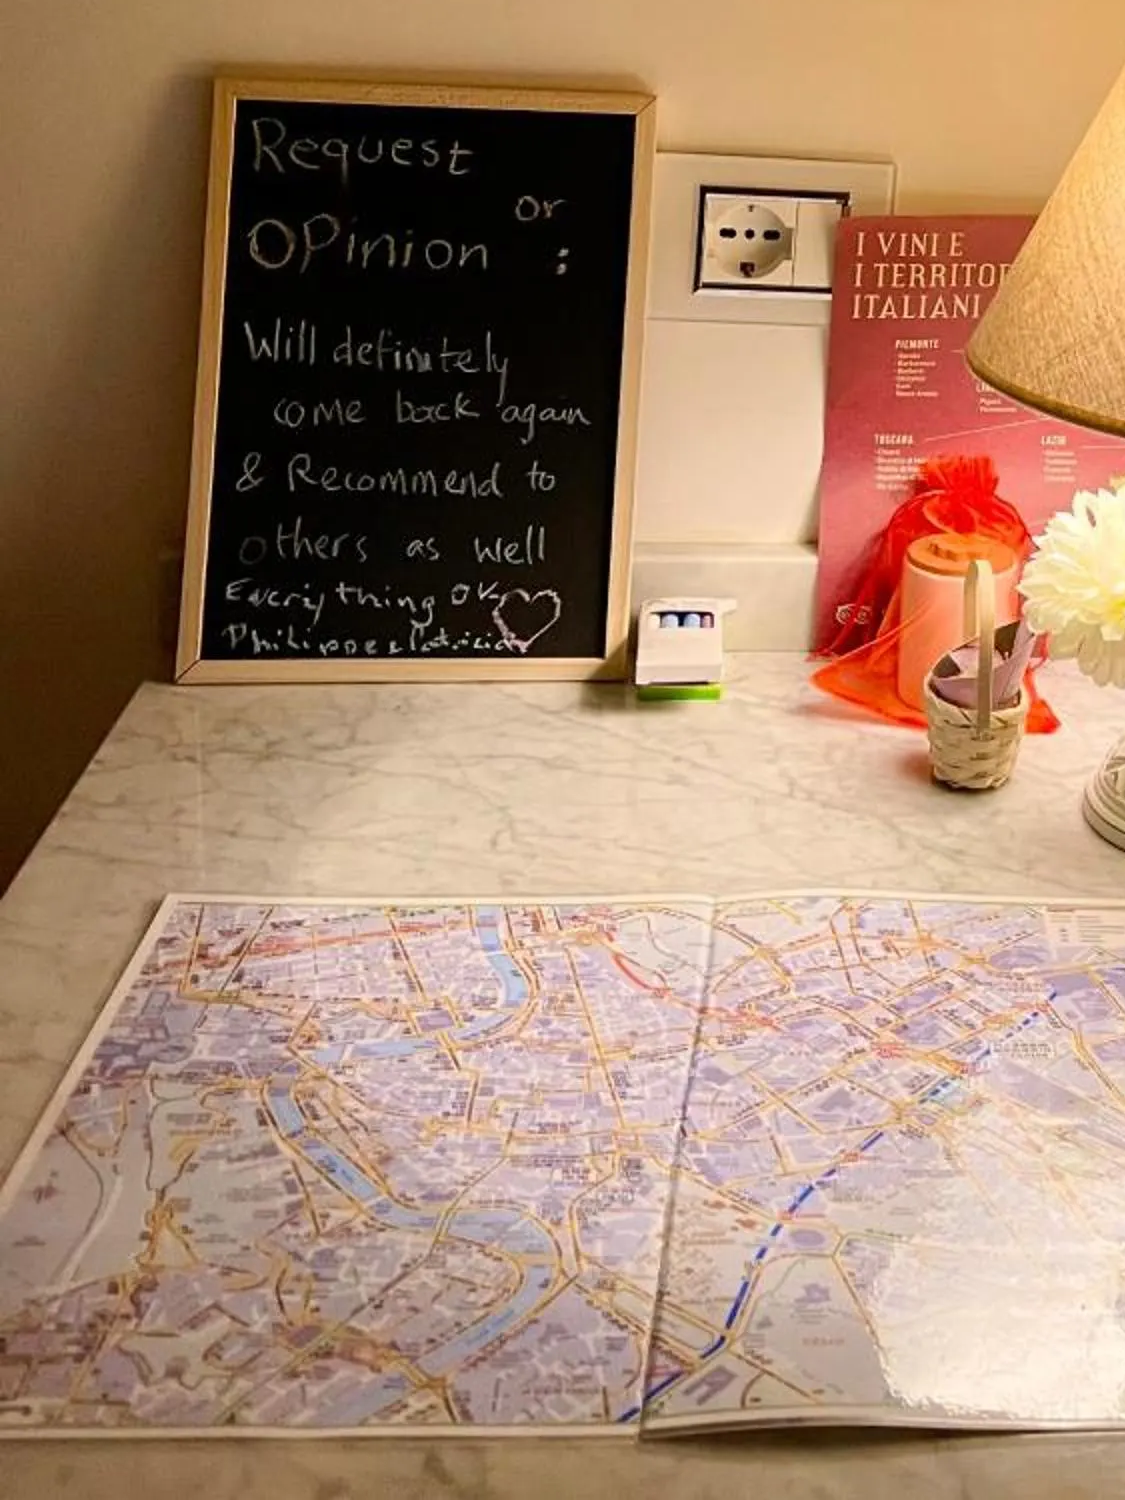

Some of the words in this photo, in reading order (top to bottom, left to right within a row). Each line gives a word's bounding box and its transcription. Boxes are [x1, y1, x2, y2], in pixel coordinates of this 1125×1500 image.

[251, 117, 473, 184] Request
[515, 195, 566, 221] or
[856, 232, 866, 257] I
[877, 231, 938, 258] VINI
[950, 232, 966, 257] E
[854, 263, 864, 288] I
[851, 294, 981, 320] ITALIANI
[244, 316, 316, 366] Will
[396, 390, 481, 423] back
[501, 398, 592, 445] again
[235, 452, 265, 491] &
[287, 453, 503, 498] Recommend
[528, 460, 557, 491] to
[406, 535, 440, 562] as
[474, 525, 546, 565] well
